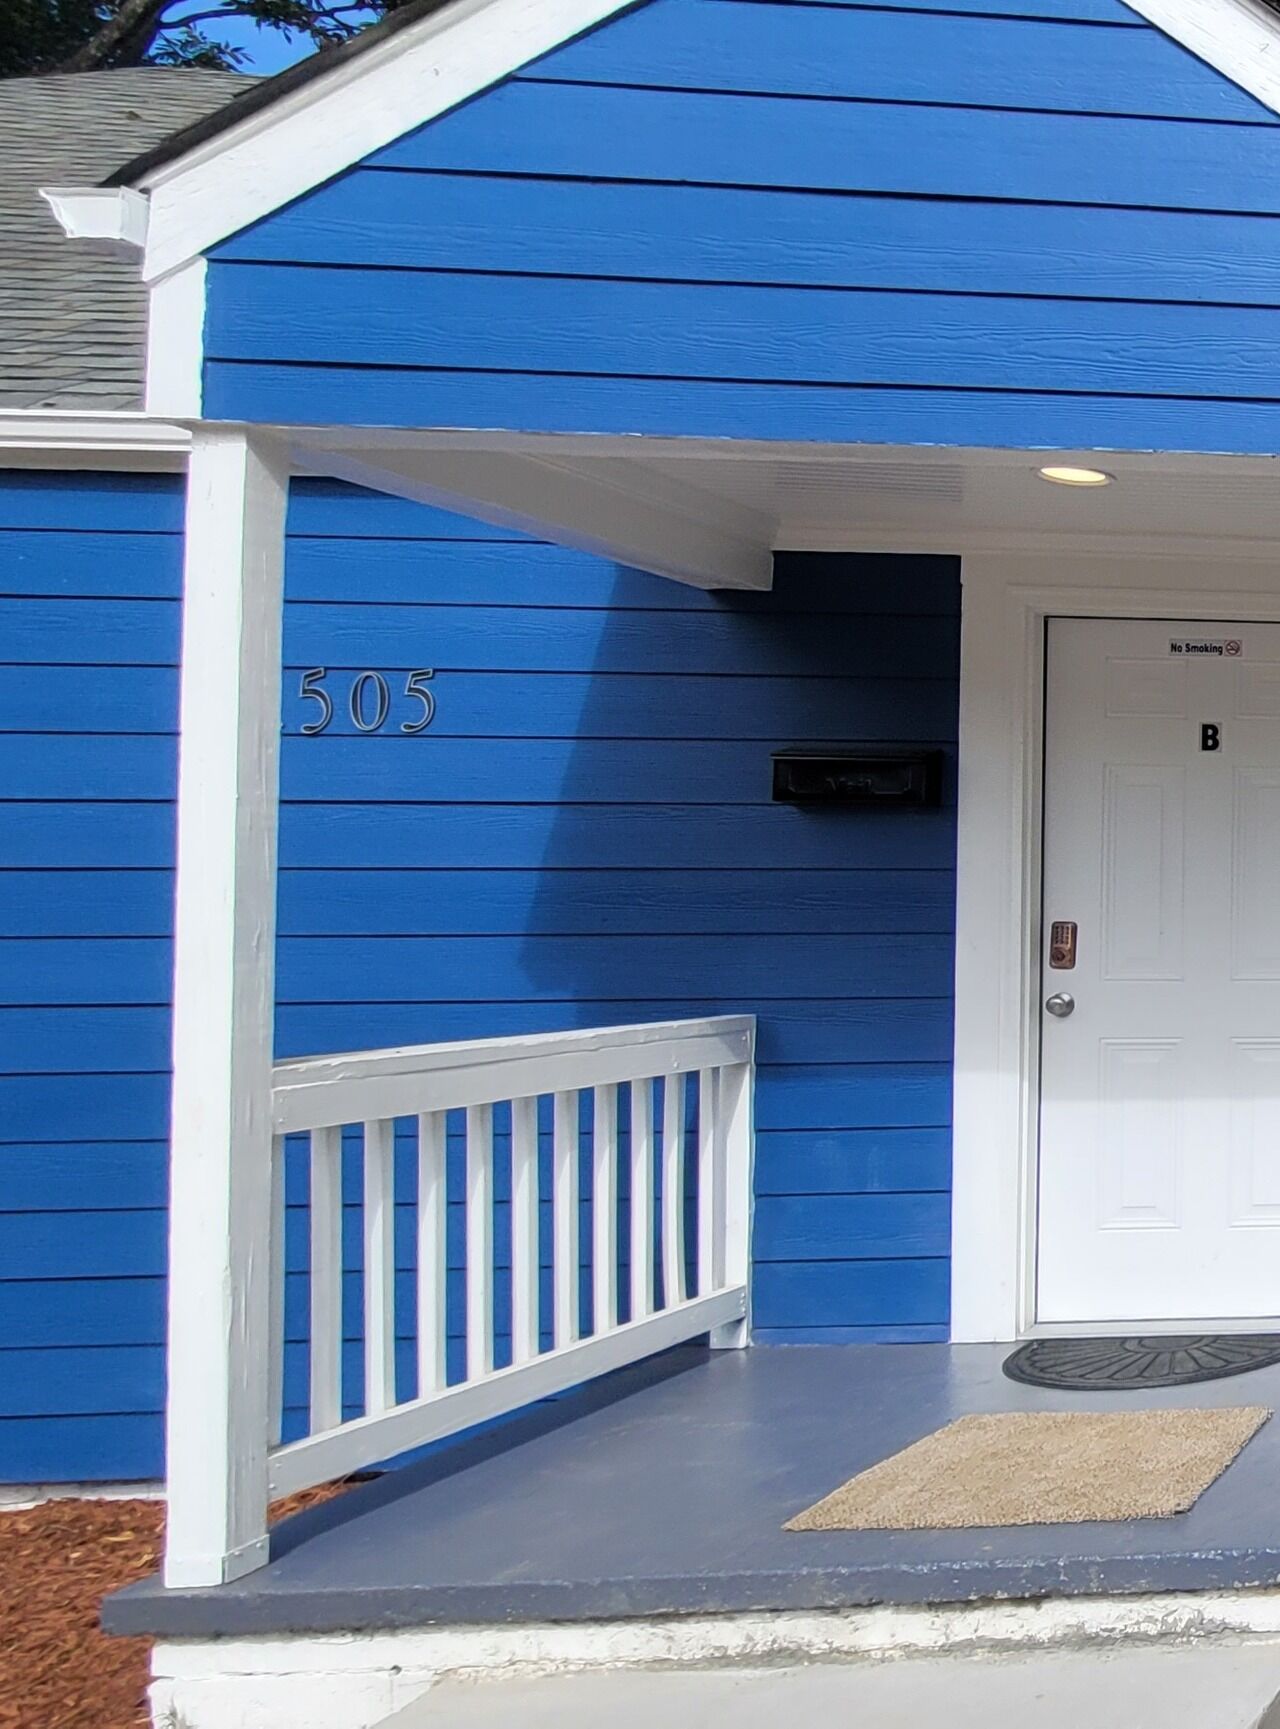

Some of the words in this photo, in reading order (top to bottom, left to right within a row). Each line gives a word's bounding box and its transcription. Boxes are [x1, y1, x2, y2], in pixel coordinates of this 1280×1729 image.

[1170, 642, 1183, 653] No
[1185, 643, 1223, 656] Smoking
[299, 667, 436, 734] 505
[1202, 724, 1220, 751] B
